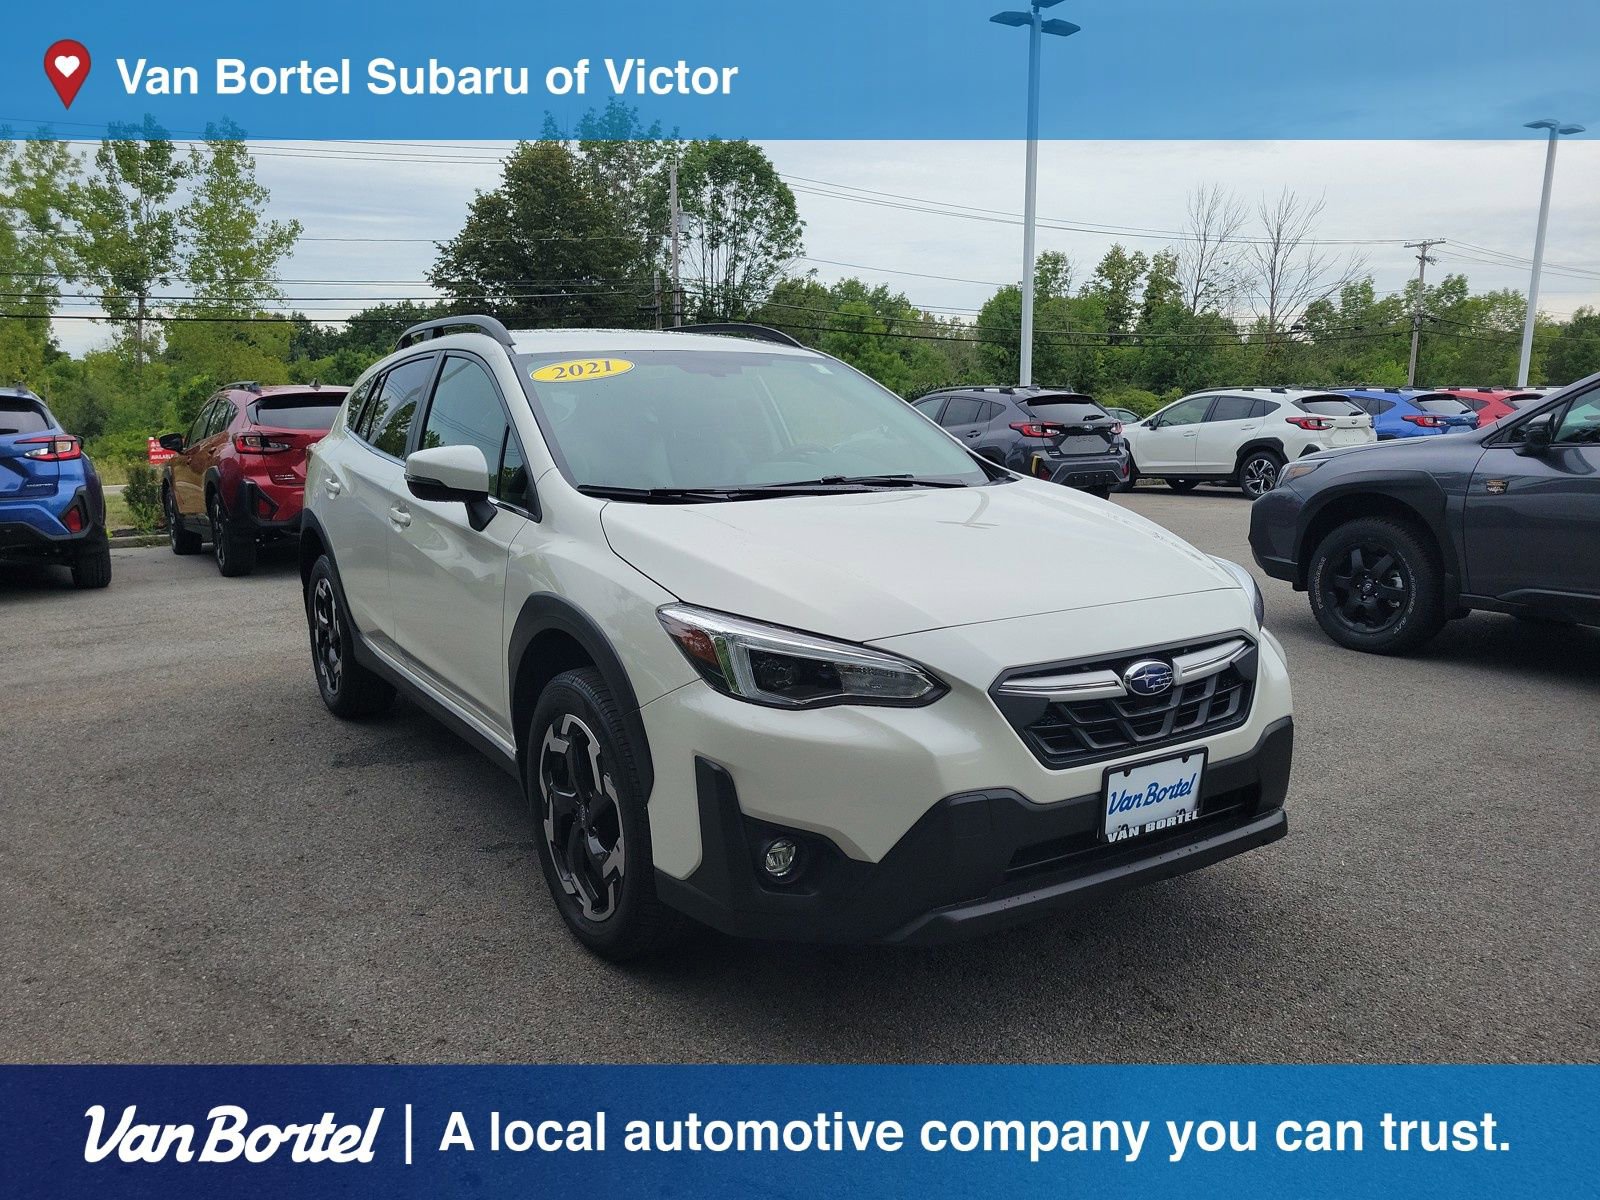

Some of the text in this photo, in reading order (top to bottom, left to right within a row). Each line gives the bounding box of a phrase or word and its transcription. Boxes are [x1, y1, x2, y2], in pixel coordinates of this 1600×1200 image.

[552, 360, 612, 379] 2021
[1107, 773, 1197, 815] Van Bortel
[1107, 810, 1200, 843] VAN BORTEL
